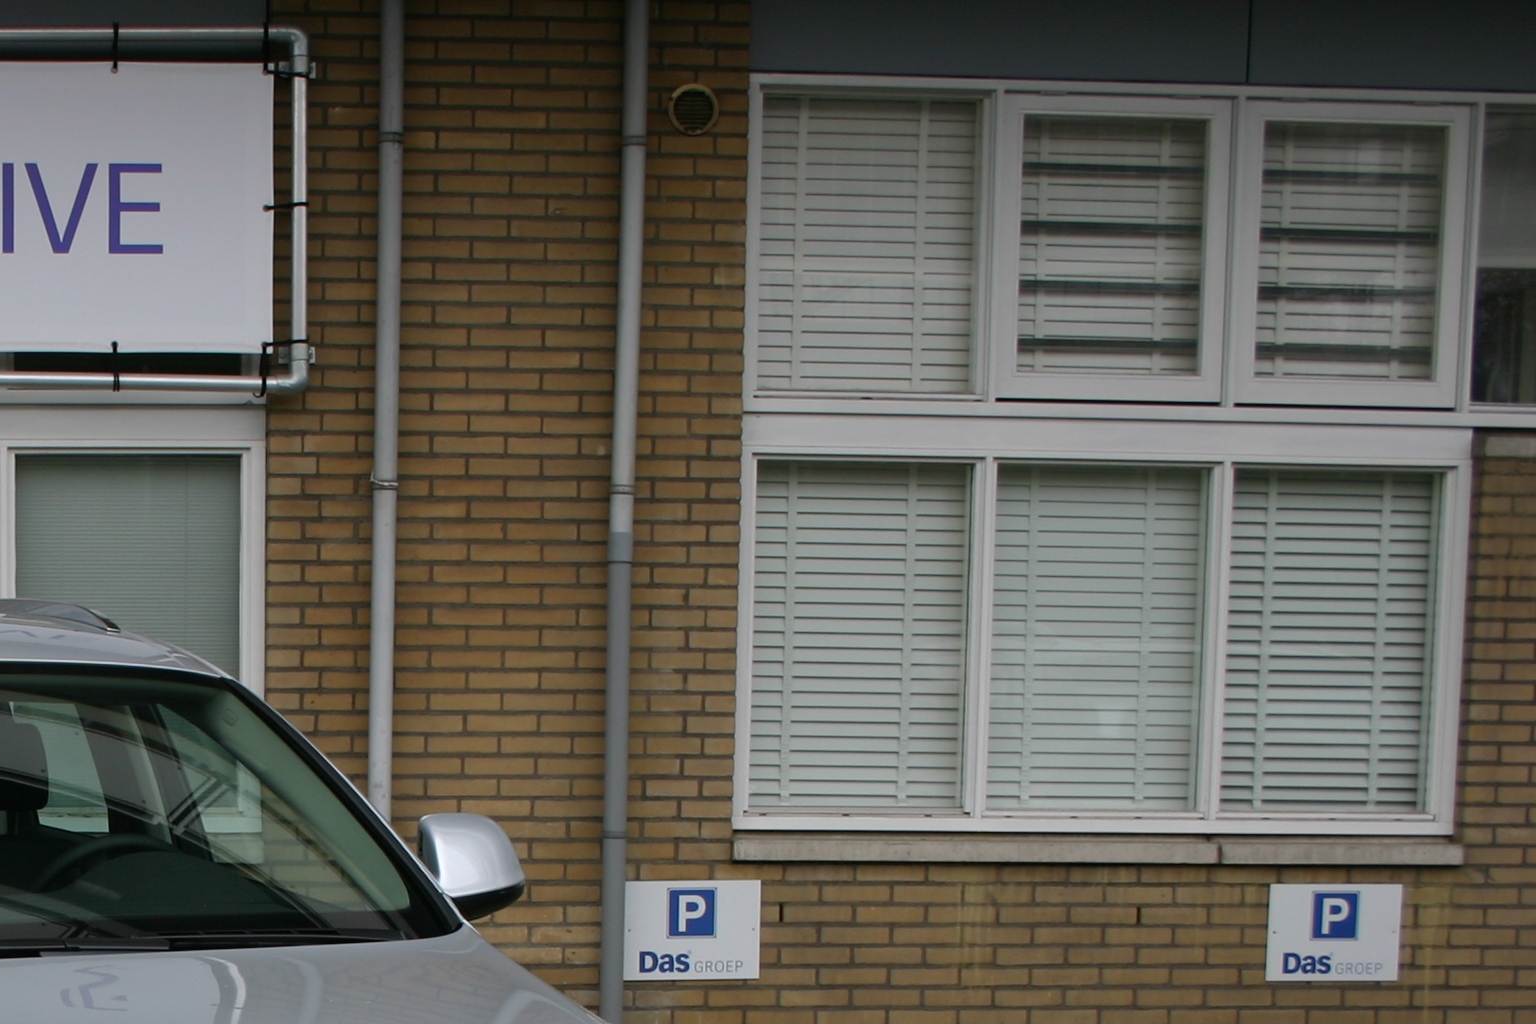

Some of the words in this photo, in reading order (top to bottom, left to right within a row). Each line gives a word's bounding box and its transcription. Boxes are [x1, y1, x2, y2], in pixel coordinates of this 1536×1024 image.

[678, 894, 707, 932] P
[1321, 897, 1350, 934] P
[638, 951, 690, 974] Das
[694, 960, 744, 974] GROEP
[1282, 952, 1332, 974] Das
[1334, 962, 1383, 975] GROEP
